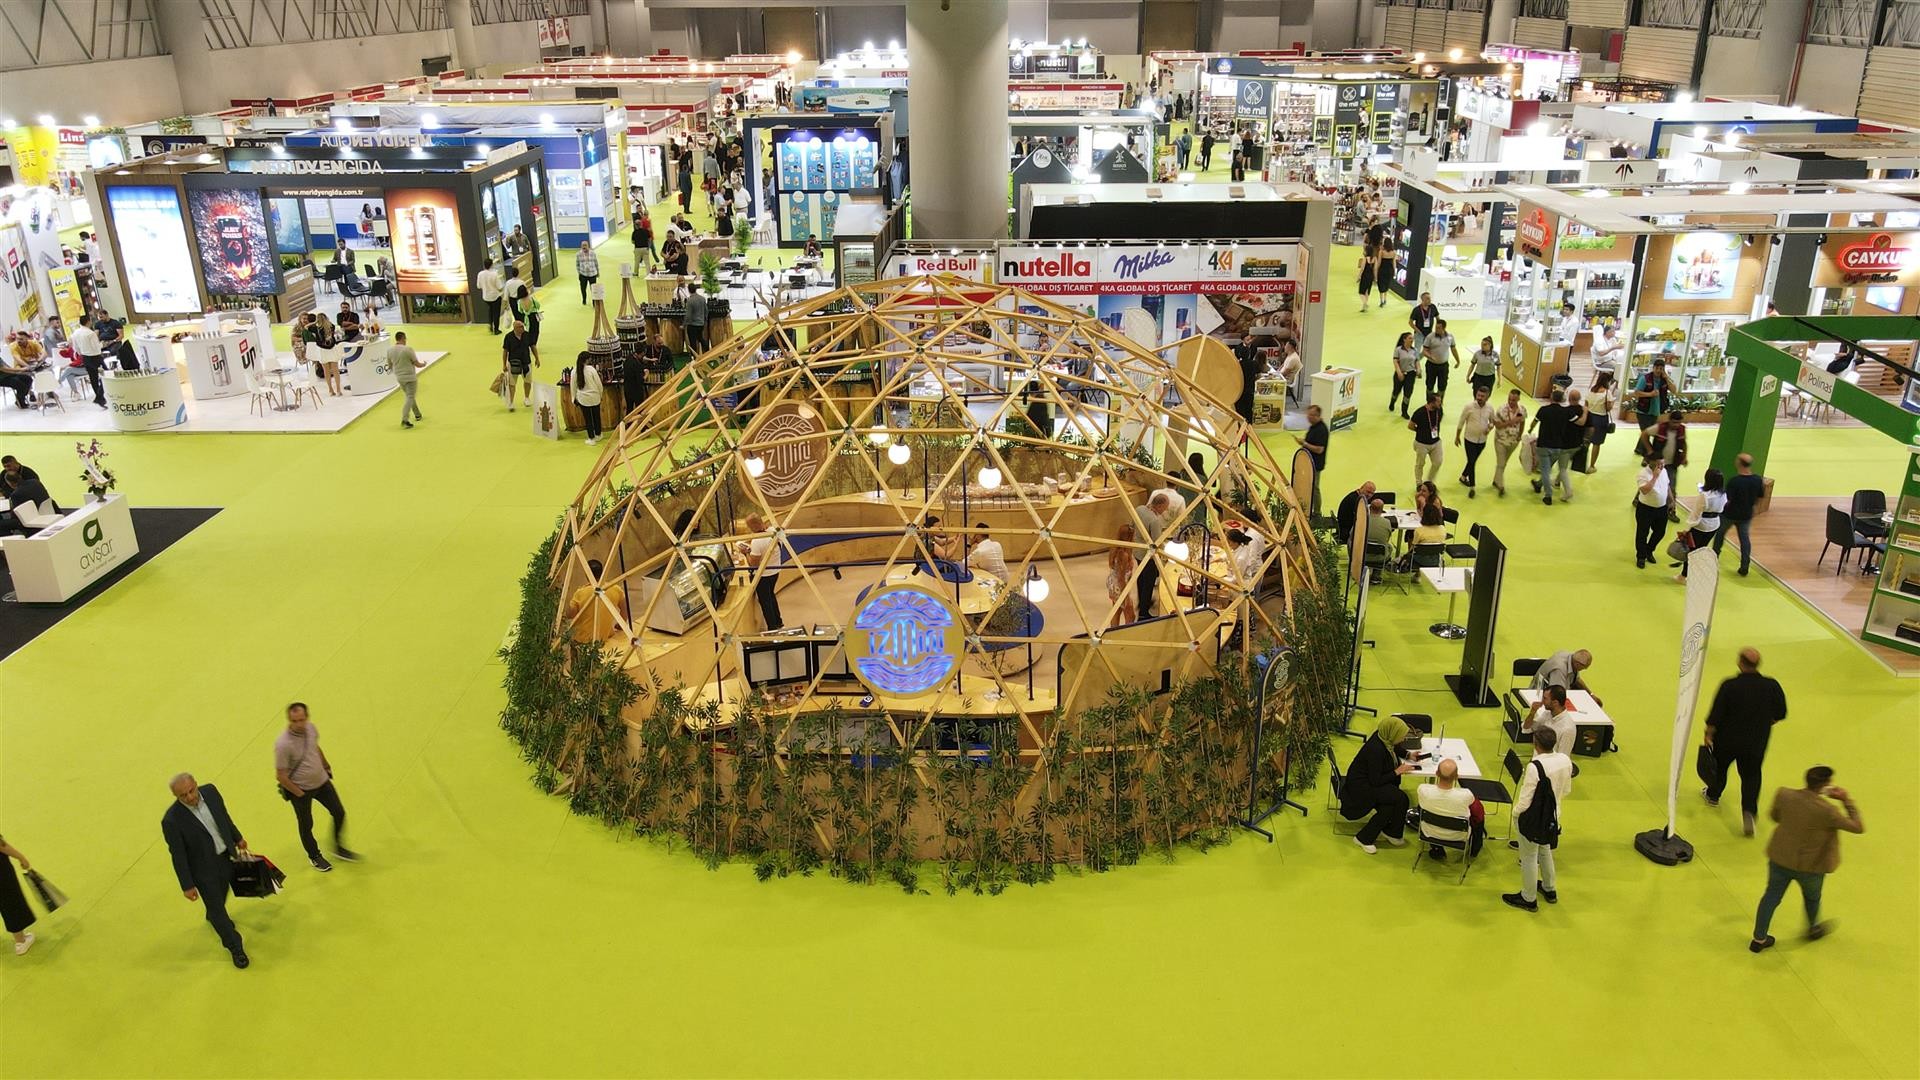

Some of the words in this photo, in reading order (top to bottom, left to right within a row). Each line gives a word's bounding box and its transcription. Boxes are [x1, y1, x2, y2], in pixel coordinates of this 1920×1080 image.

[1238, 106, 1252, 115] the
[1253, 106, 1267, 114] mill
[917, 259, 946, 271] Red
[948, 259, 977, 271] Bull
[1004, 253, 1091, 277] nutella
[1113, 249, 1175, 279] Milka
[1019, 284, 1046, 292] GLOBAL
[1049, 284, 1061, 293] DIŞ
[1066, 283, 1093, 291] TİCARET
[1148, 284, 1160, 293] DIŞ
[1162, 282, 1192, 291] TİCARET
[1247, 284, 1260, 293] DIŞ
[1262, 282, 1293, 291] TİCARET
[1807, 372, 1832, 394] Polinas
